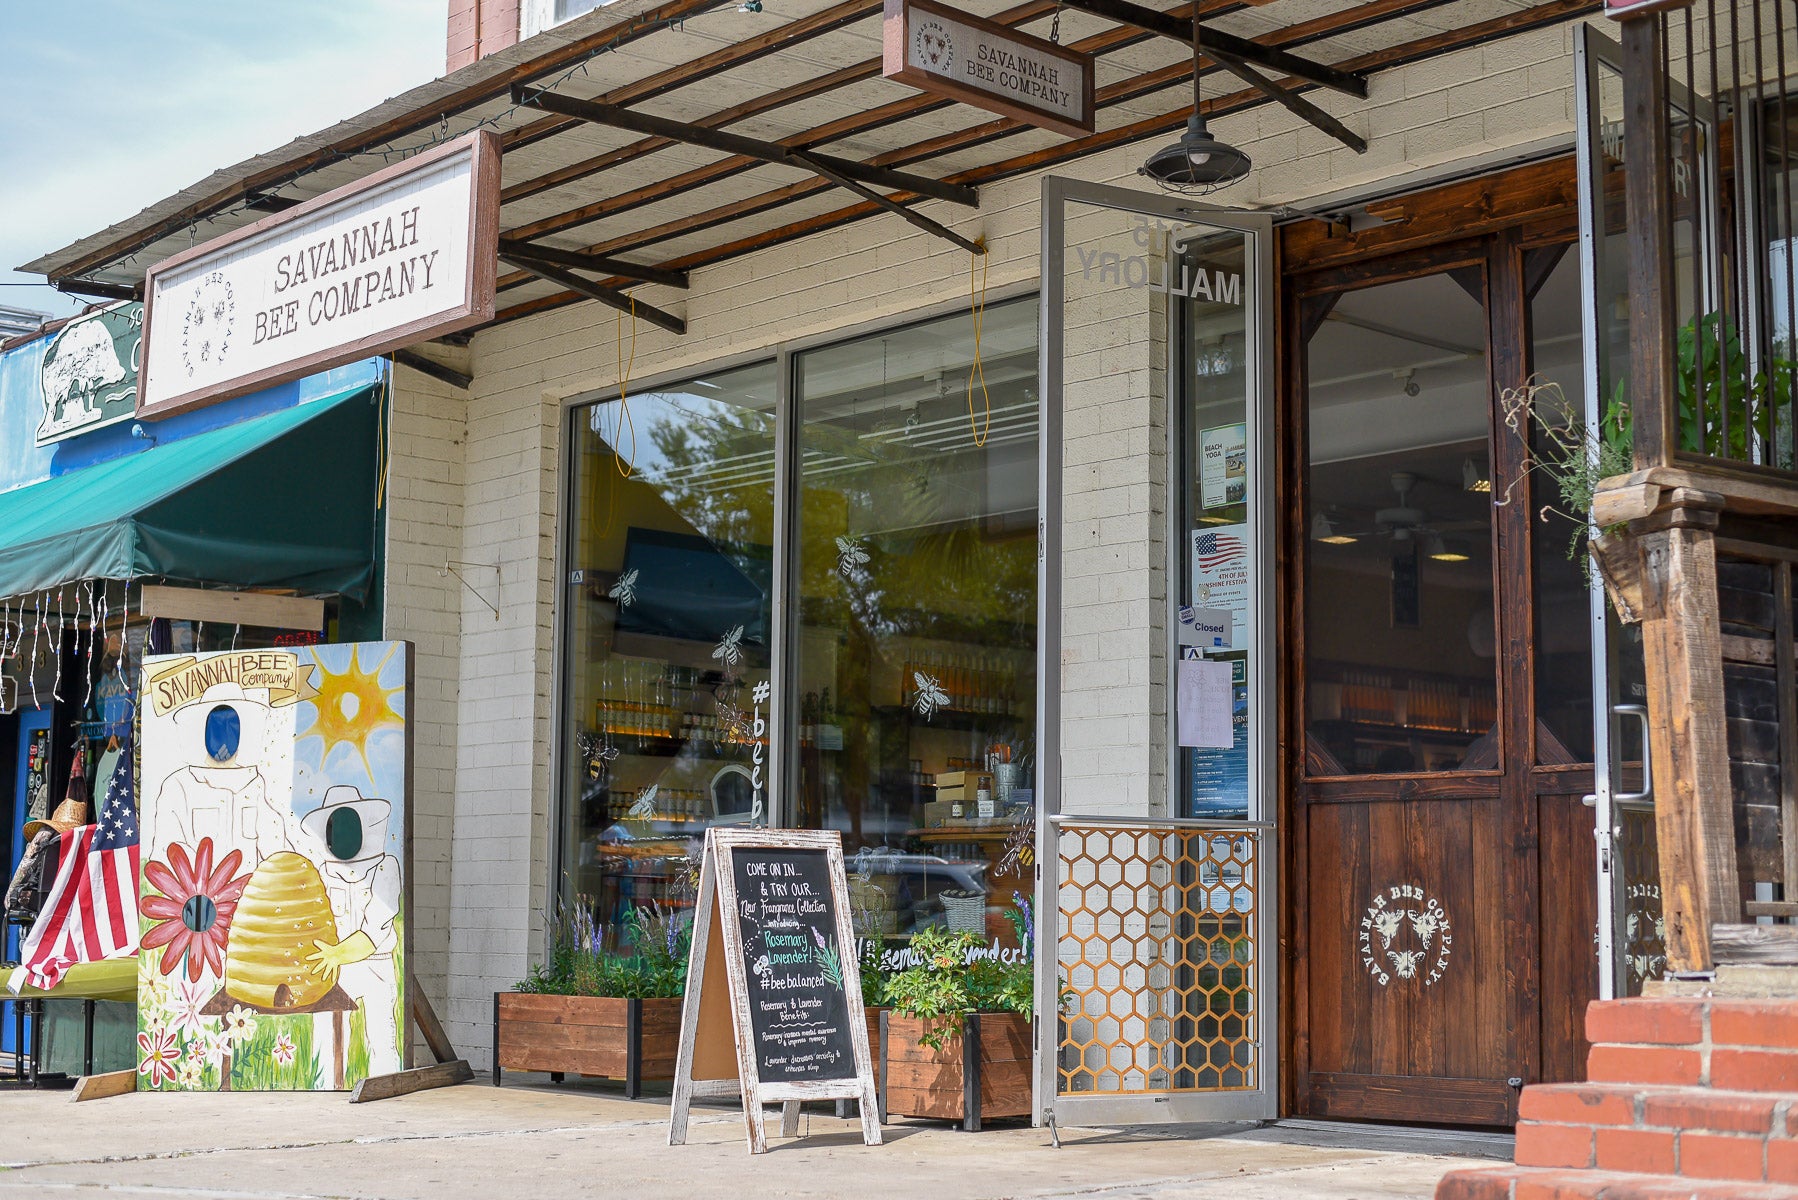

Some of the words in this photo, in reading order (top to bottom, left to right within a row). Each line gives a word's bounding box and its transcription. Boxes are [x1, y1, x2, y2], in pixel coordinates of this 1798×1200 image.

[978, 44, 1060, 86] SAVANNAH
[966, 60, 995, 83] BEE
[999, 72, 1070, 108] COMPANY
[273, 206, 420, 294] SAVANNAH
[253, 300, 299, 346] BEE
[308, 250, 440, 327] COMPANY
[1206, 451, 1222, 459] YOGA
[1195, 622, 1224, 632] Closed
[158, 657, 241, 710] SAVANNAH
[241, 654, 288, 671] BEE
[241, 671, 293, 688] company
[751, 680, 770, 829] #beeb
[746, 863, 767, 876] COME
[770, 863, 781, 876] ON
[760, 881, 768, 896] &
[770, 882, 787, 897] TRY
[740, 899, 756, 917] New
[796, 898, 827, 916] Collection
[764, 930, 808, 952] Rosemary
[1360, 894, 1389, 986] SAVANNAH
[1390, 884, 1424, 901] BEE
[767, 946, 812, 965] Lavender!
[760, 1000, 787, 1013] Rosemary
[798, 997, 823, 1009] Lavender
[762, 1032, 783, 1045] Rosemary
[809, 1036, 827, 1045] memory
